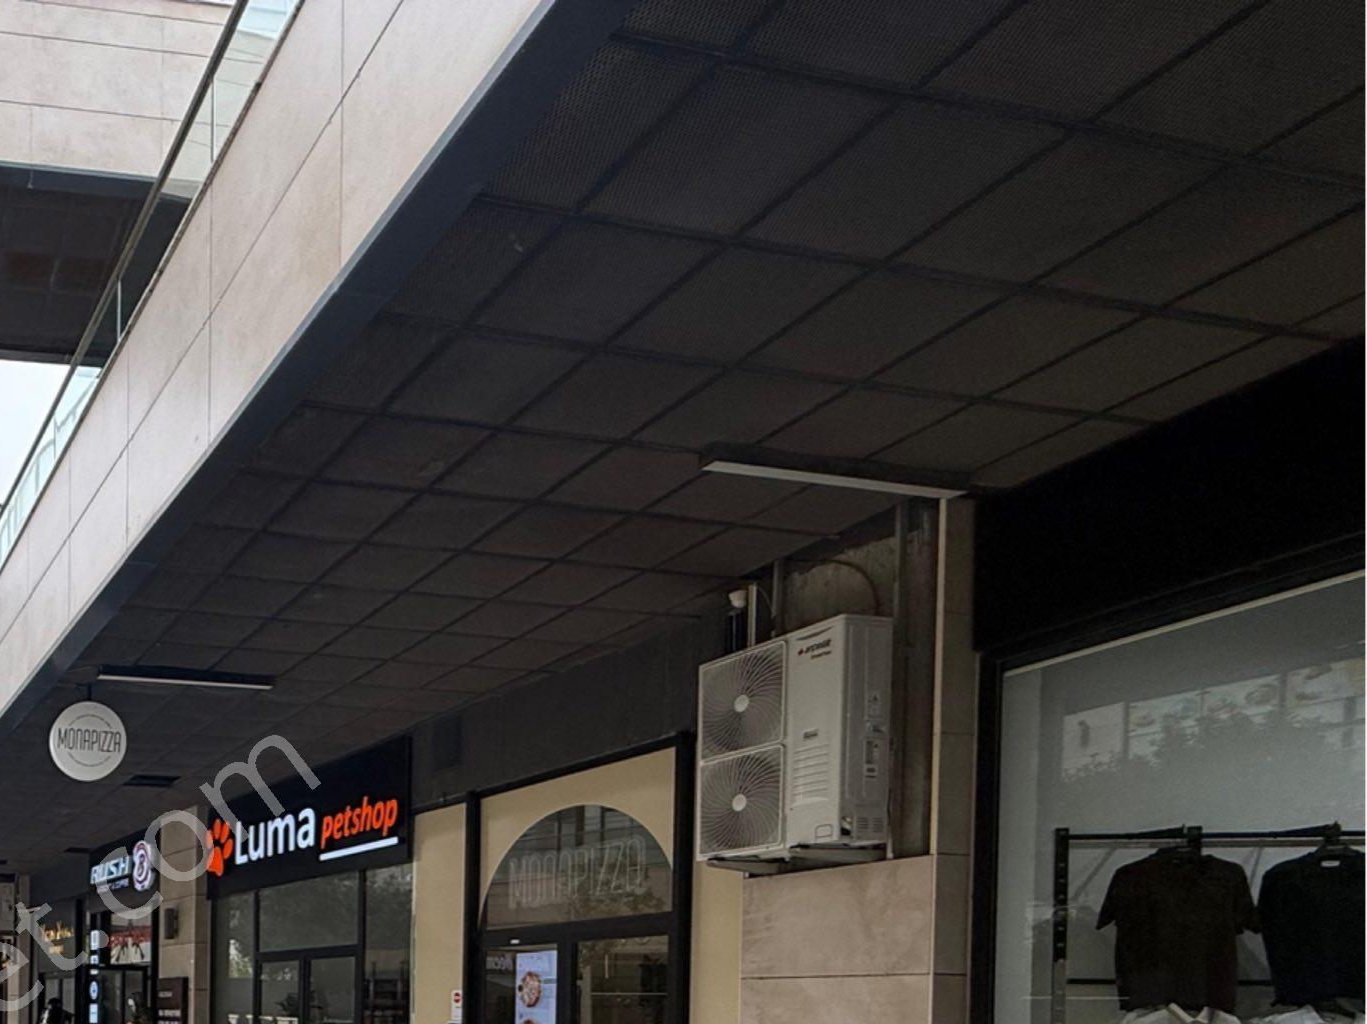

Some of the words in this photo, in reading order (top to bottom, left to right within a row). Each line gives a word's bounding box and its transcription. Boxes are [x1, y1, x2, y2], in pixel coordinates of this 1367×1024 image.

[57, 727, 122, 753] MONAPIZZA
[235, 807, 317, 866] Luma
[320, 795, 399, 850] petshop
[90, 855, 132, 885] RUSH
